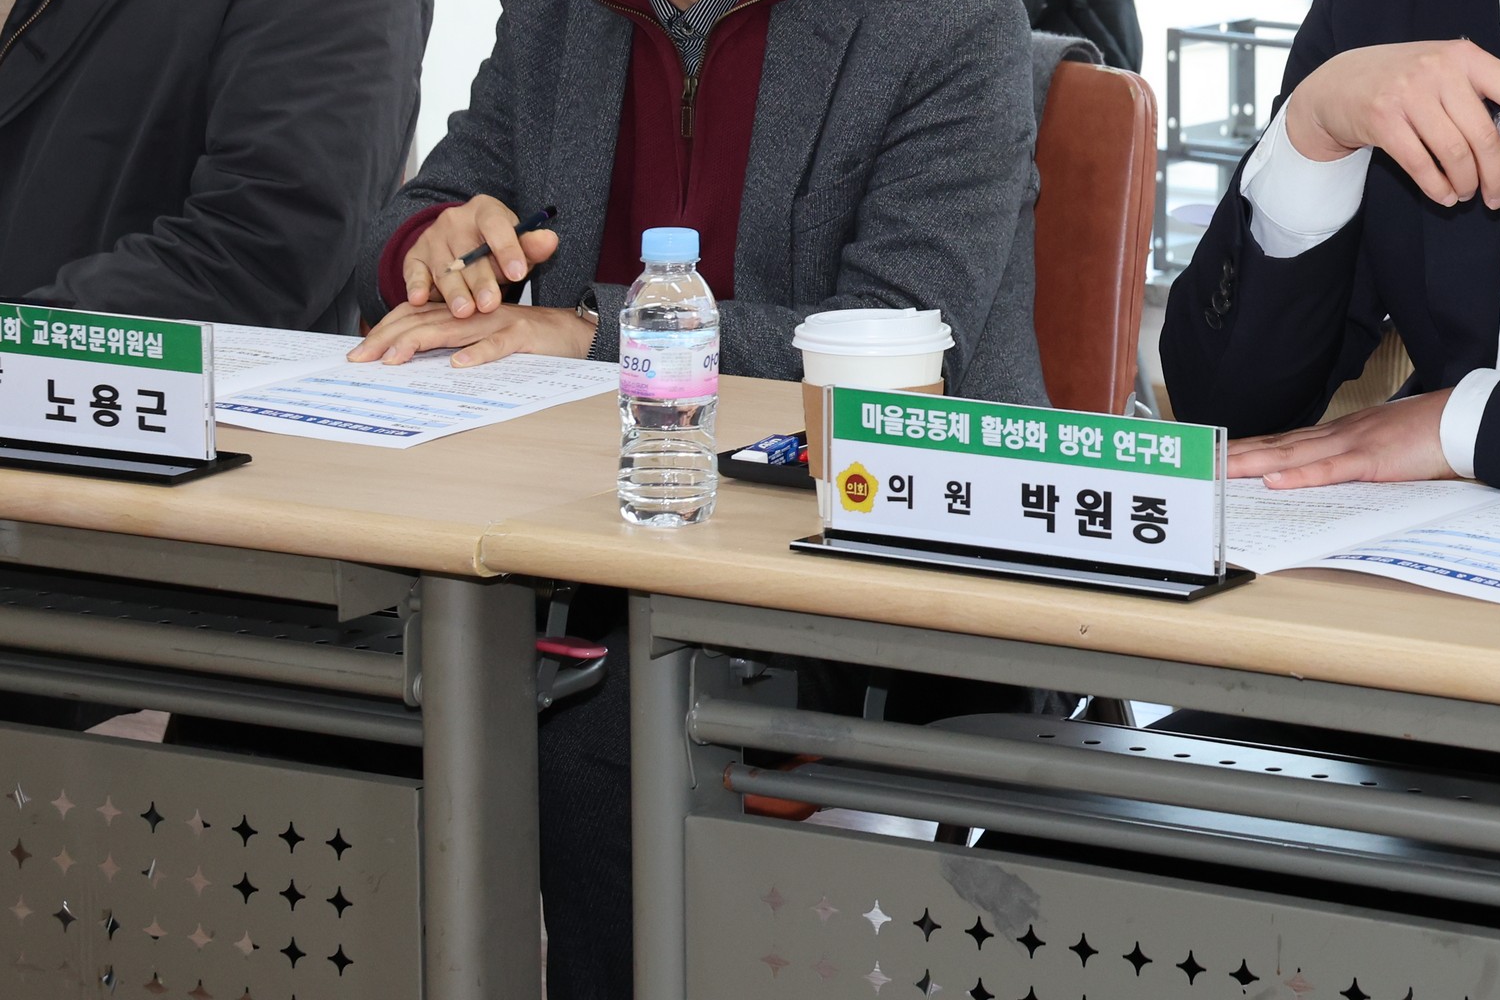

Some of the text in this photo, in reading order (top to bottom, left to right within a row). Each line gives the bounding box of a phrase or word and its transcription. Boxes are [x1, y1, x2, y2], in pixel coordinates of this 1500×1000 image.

[0, 315, 164, 359] 회 교육전문위원실
[45, 379, 167, 433] 노용근
[861, 403, 1182, 468] 마을공동체 활성화 방안 연구회
[846, 481, 868, 497] 의회
[1021, 483, 1169, 544] 박원종
